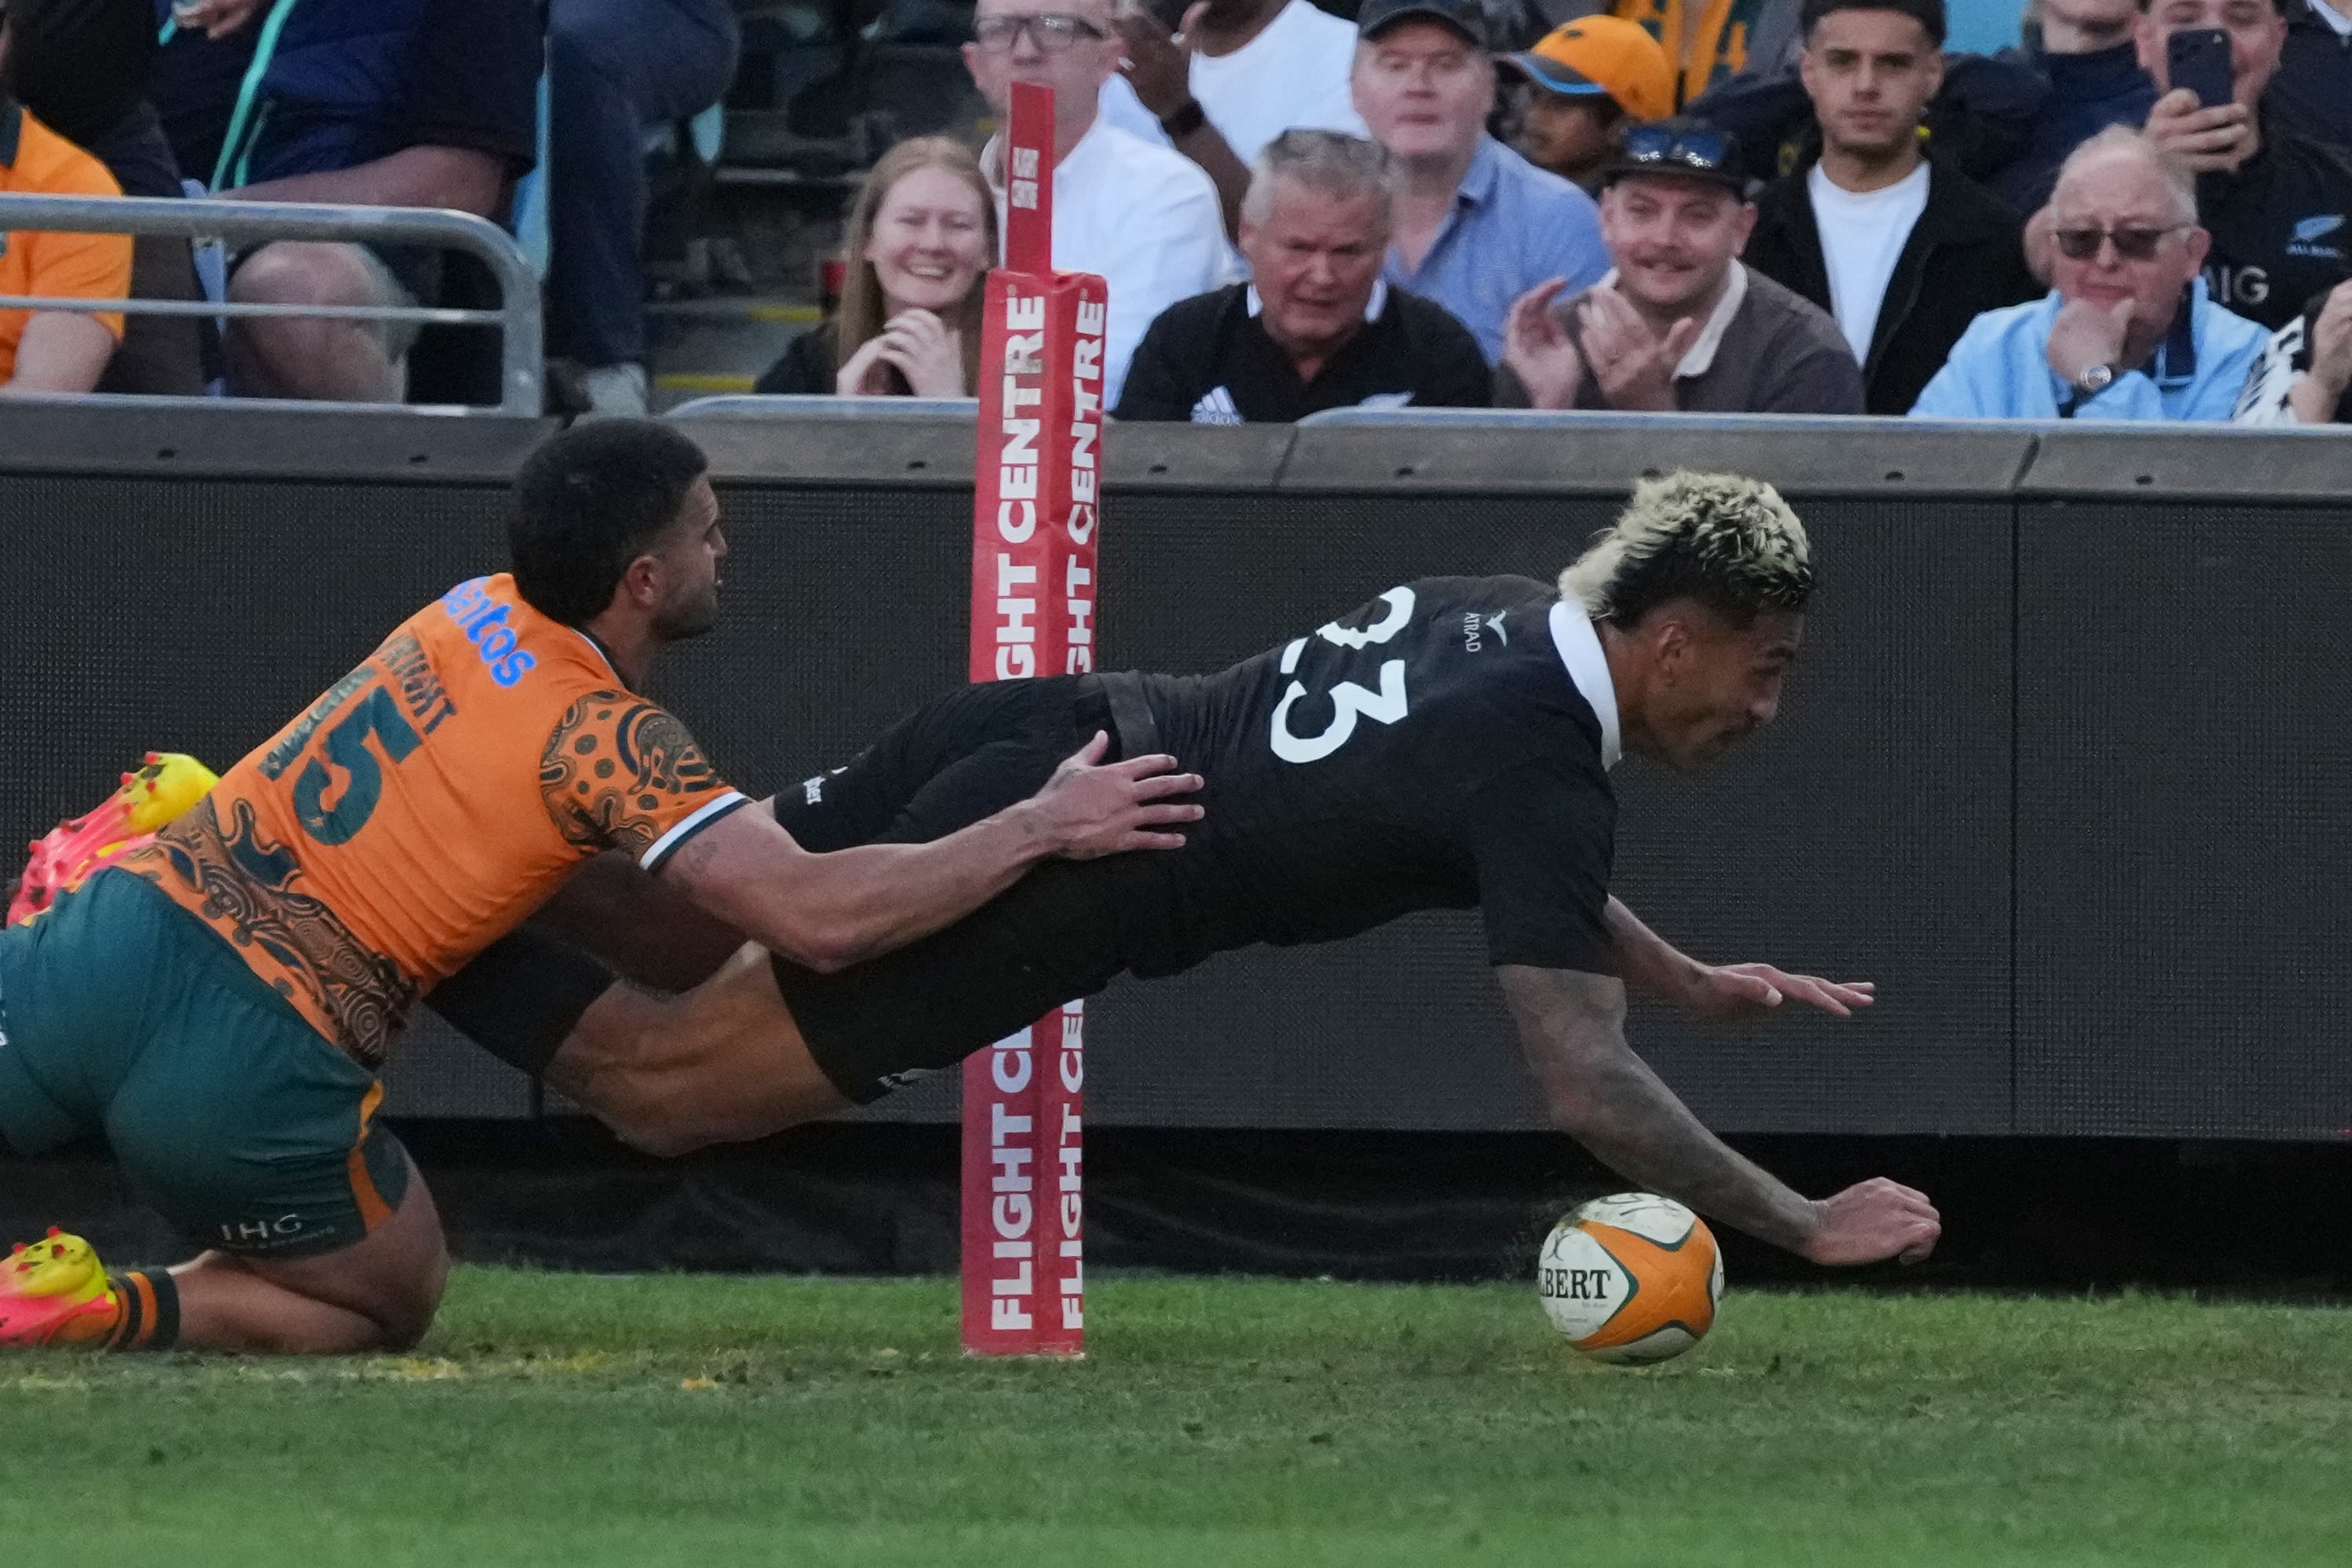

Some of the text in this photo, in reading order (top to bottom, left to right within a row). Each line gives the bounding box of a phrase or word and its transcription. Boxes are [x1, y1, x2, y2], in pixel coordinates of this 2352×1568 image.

[995, 296, 1045, 681] GHT CENTRE
[1066, 301, 1105, 675] GHT CENTRE
[222, 1214, 302, 1241] IHG
[991, 1103, 1033, 1330] FLIGHT
[1059, 1103, 1083, 1329] FLIGHT
